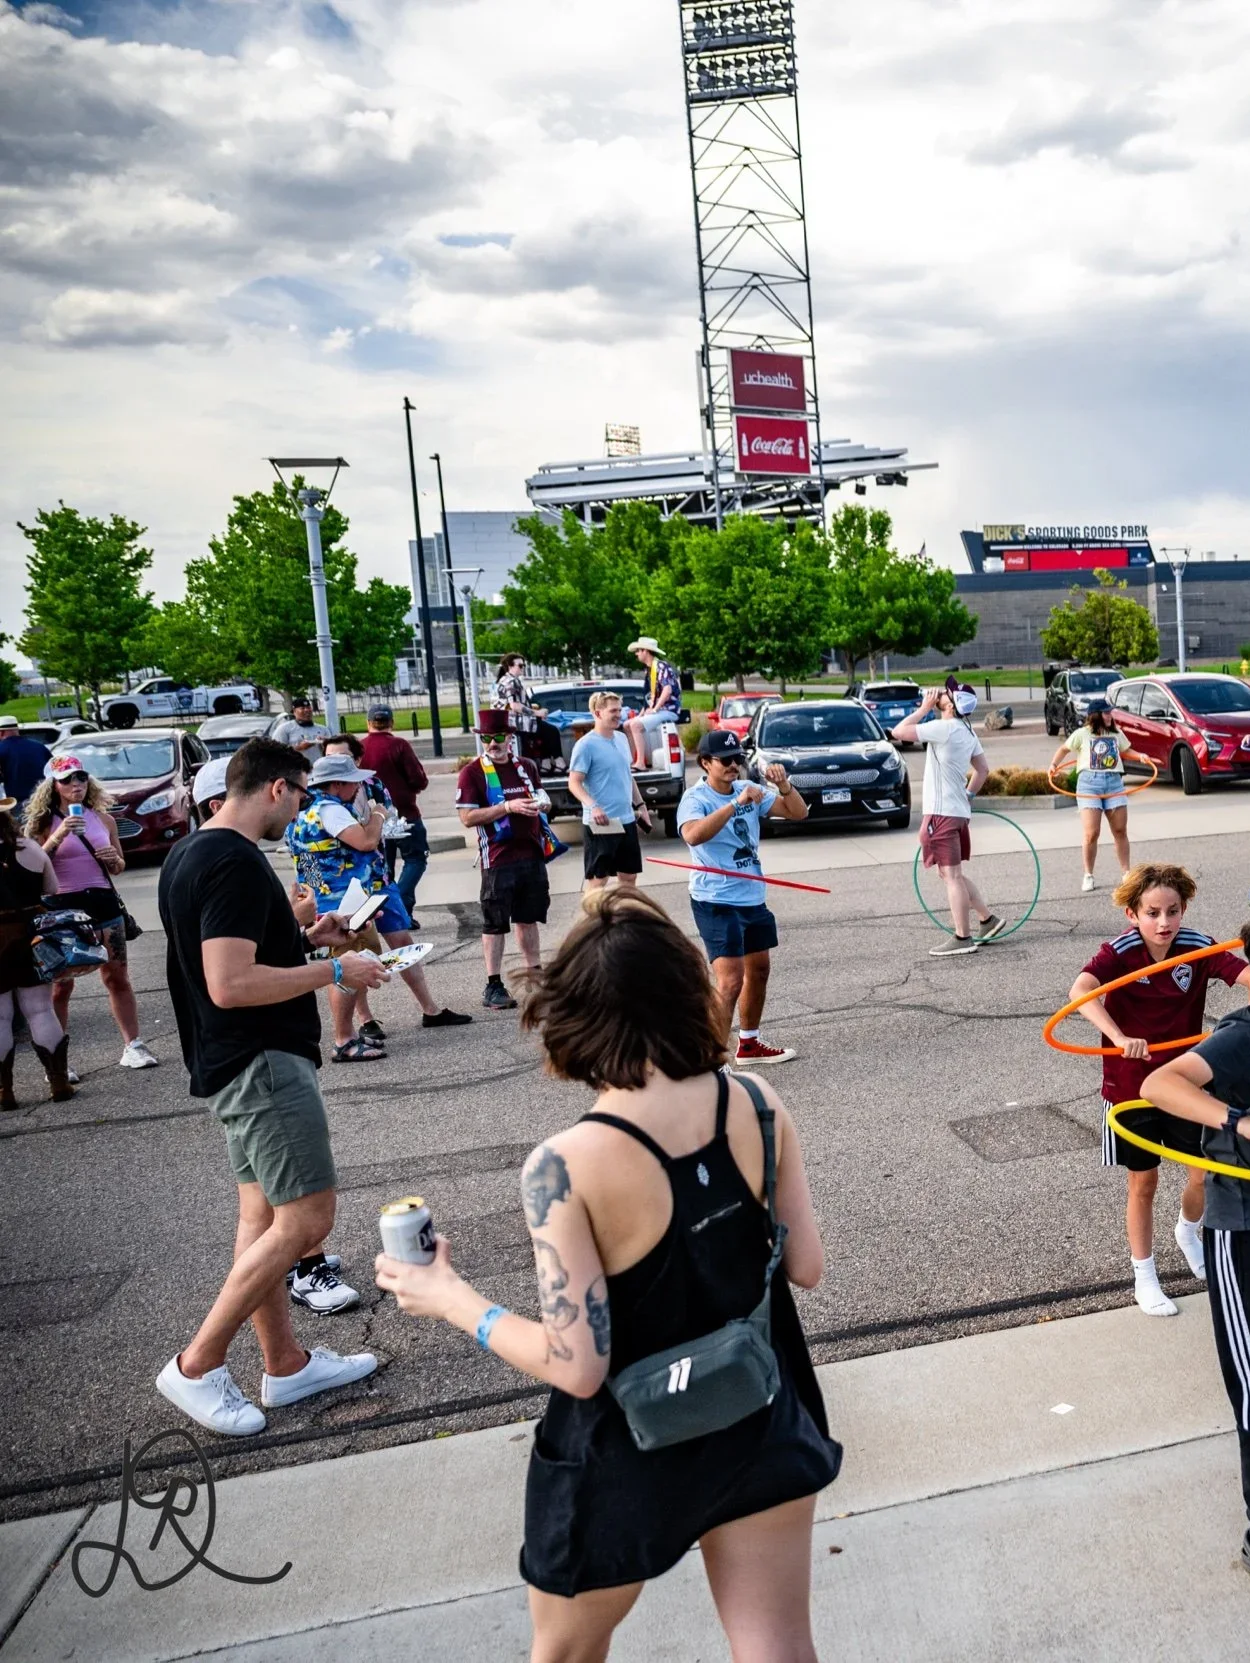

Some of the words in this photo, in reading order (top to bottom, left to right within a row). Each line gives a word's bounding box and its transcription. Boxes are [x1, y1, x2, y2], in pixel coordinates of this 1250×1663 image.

[744, 370, 793, 388] uchealth
[1028, 526, 1081, 539] SPORTING
[1083, 525, 1118, 539] GOODS
[1121, 525, 1148, 538] PARK
